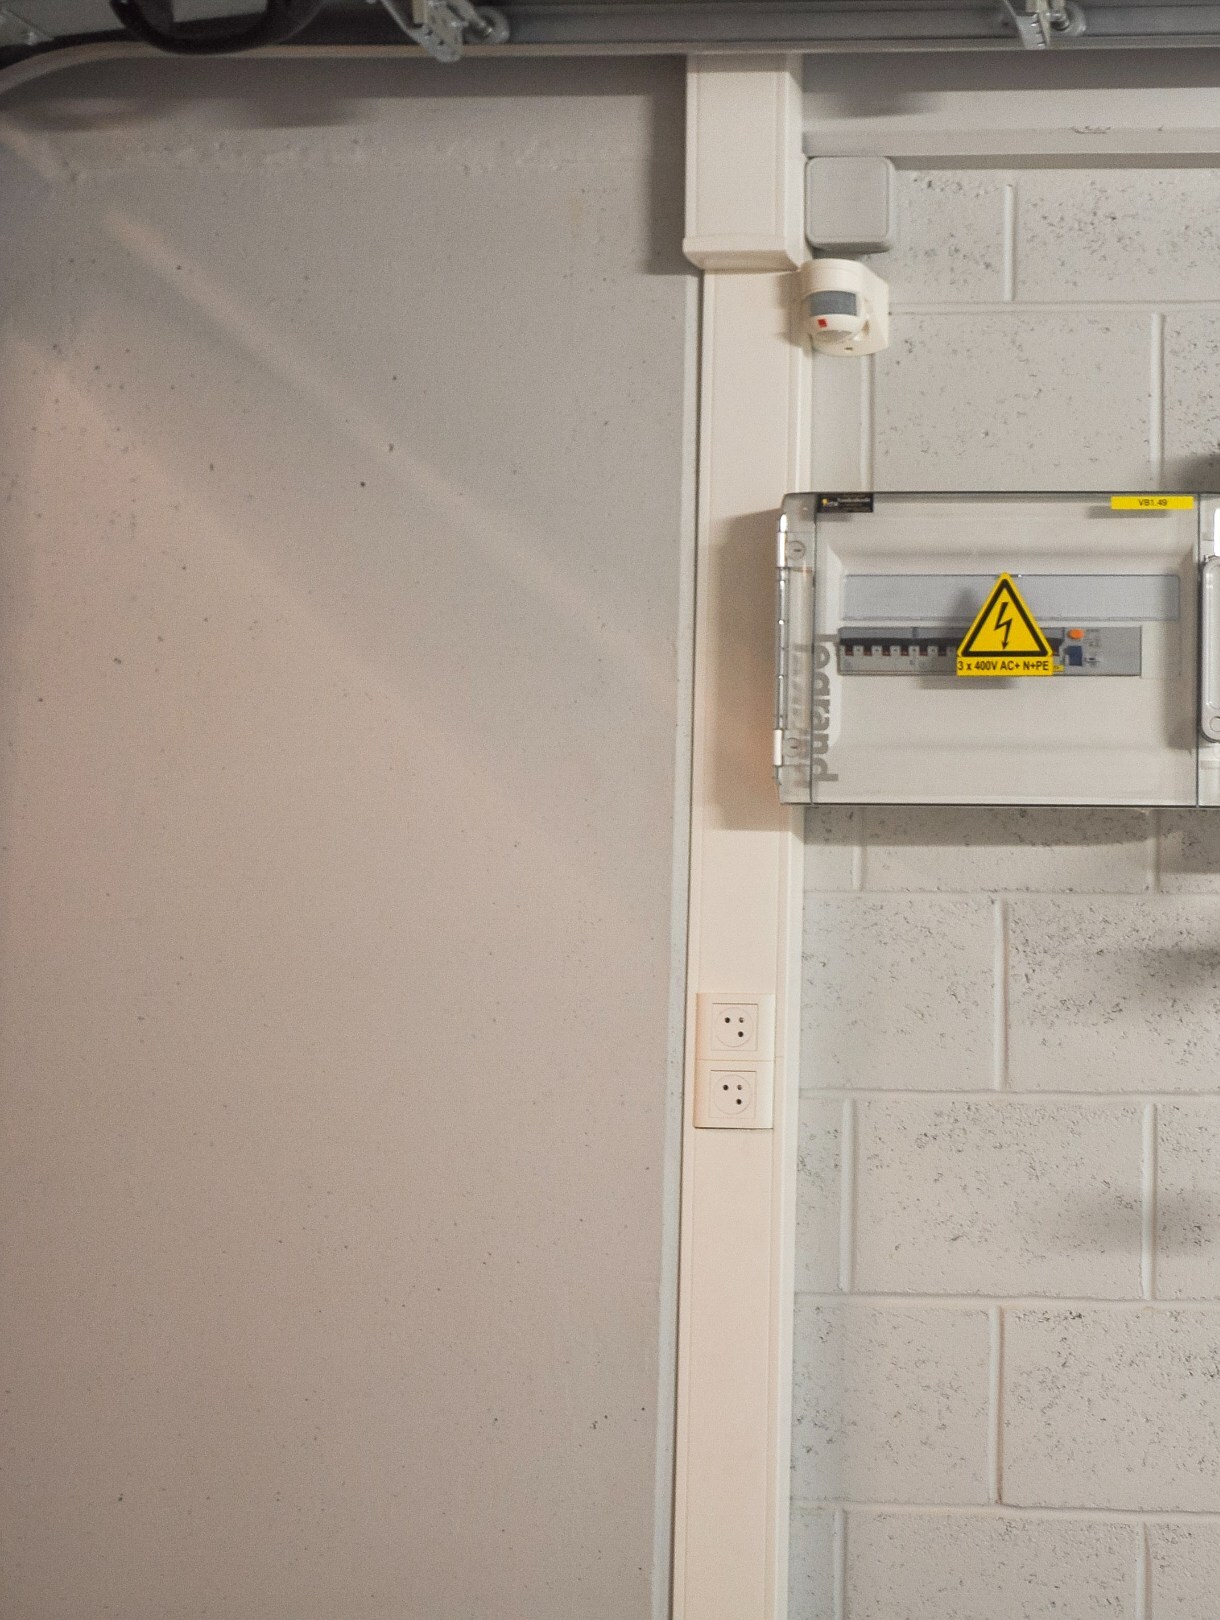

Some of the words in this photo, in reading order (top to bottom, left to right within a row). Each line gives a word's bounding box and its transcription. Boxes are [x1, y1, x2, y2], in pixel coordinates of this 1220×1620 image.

[957, 660, 964, 671] 3
[974, 660, 998, 671] 400V
[1022, 660, 1049, 671] N+PE
